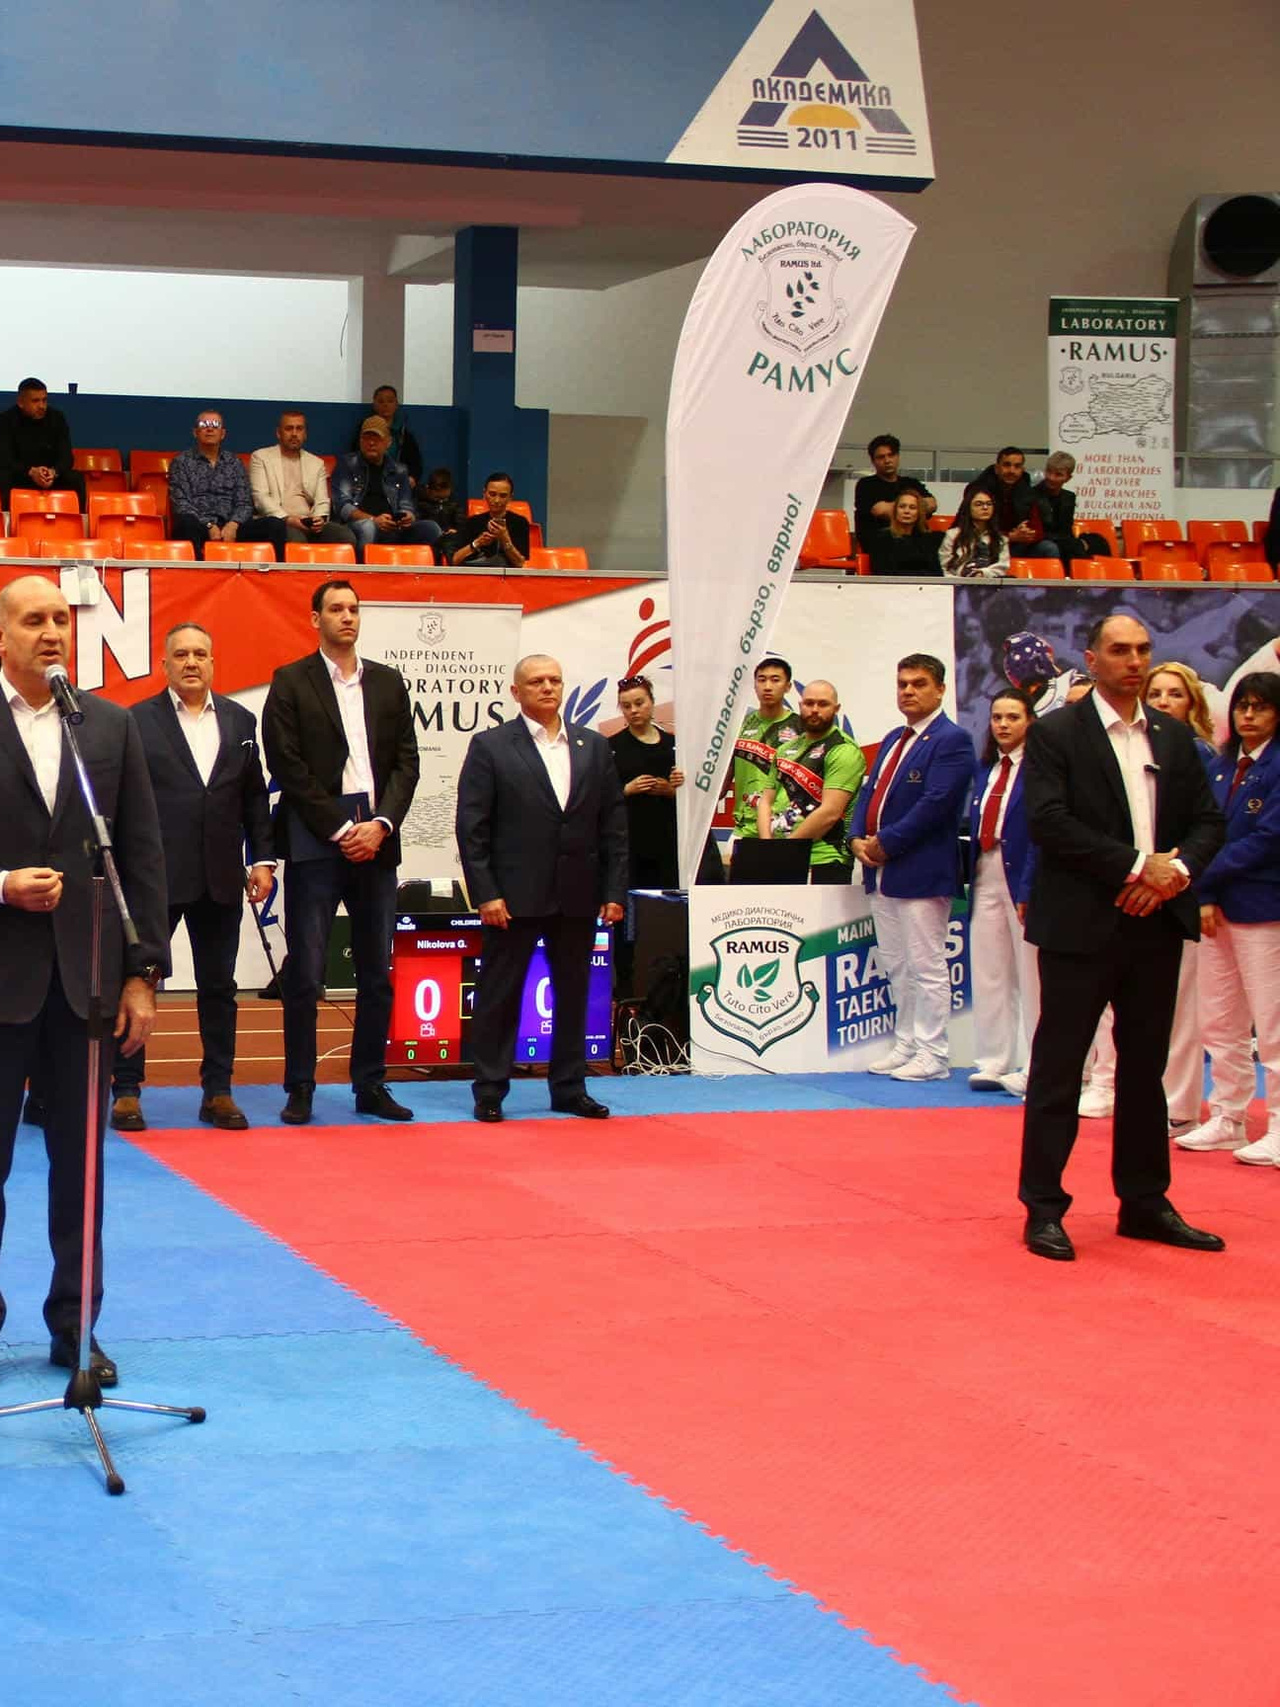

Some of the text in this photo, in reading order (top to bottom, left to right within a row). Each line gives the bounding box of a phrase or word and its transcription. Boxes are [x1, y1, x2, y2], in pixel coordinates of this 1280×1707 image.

[752, 78, 892, 106] АКАДЕМИКА
[796, 127, 858, 150] 2011
[741, 220, 861, 262] ЛАБОРАТОРИЯ
[1061, 317, 1167, 330] LABORATORY
[747, 348, 858, 393] РАМУС
[694, 663, 749, 793] Безопасно,
[739, 582, 777, 655] бързо,
[766, 493, 803, 574] вярно!
[384, 650, 475, 661] INDEPENDENT
[425, 664, 507, 674] DIAGNOSTIC
[724, 917, 793, 930] ЛАБОРАТОРИЯ
[837, 919, 874, 945] MAIN
[417, 940, 455, 949] Nikolova
[726, 940, 790, 954] RAMUS
[415, 979, 441, 1022] 0
[723, 990, 796, 1014] Tuto Cito Vere
